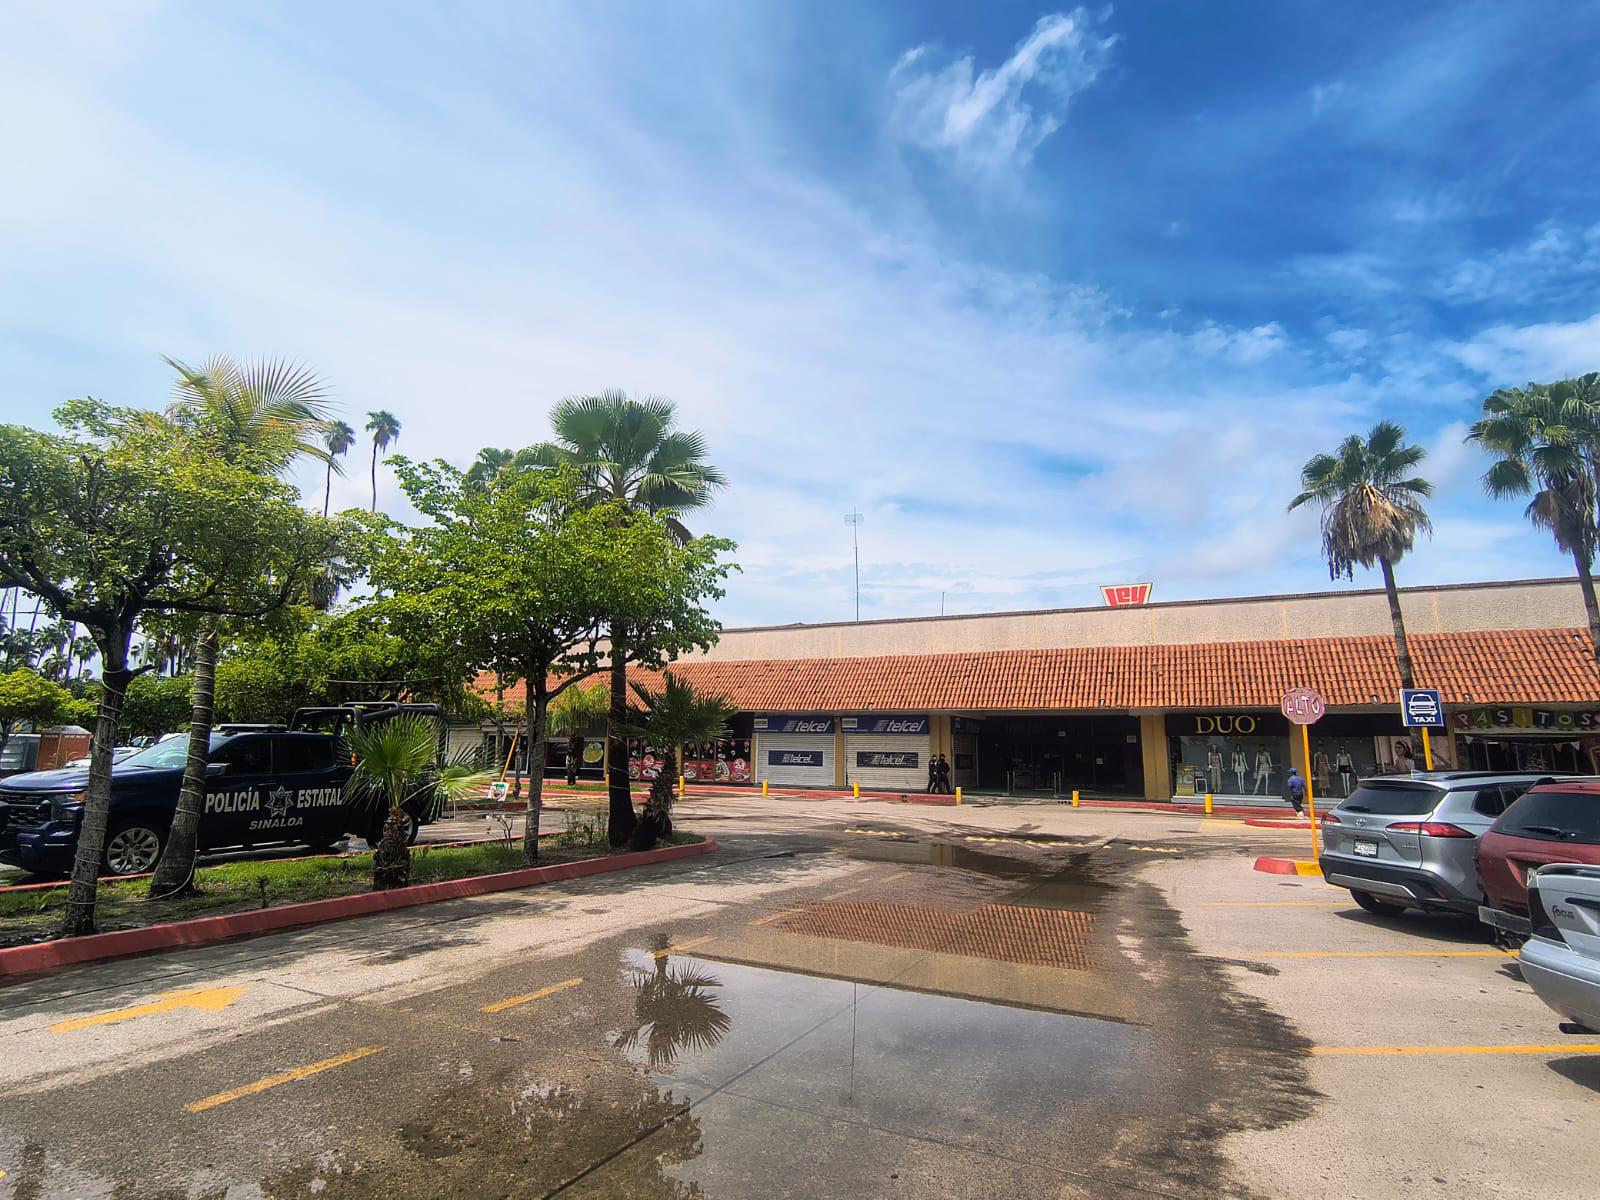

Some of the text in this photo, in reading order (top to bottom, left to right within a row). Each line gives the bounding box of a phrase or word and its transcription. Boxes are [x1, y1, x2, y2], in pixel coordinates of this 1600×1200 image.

[1286, 695, 1320, 715] ALTO
[795, 720, 831, 732] telcel
[886, 719, 925, 732] telcel
[1194, 715, 1256, 734] DUO
[1457, 710, 1592, 727] PASITOS
[204, 786, 343, 813] POLICÍA ESTATAL
[249, 816, 304, 830] SINALOA
